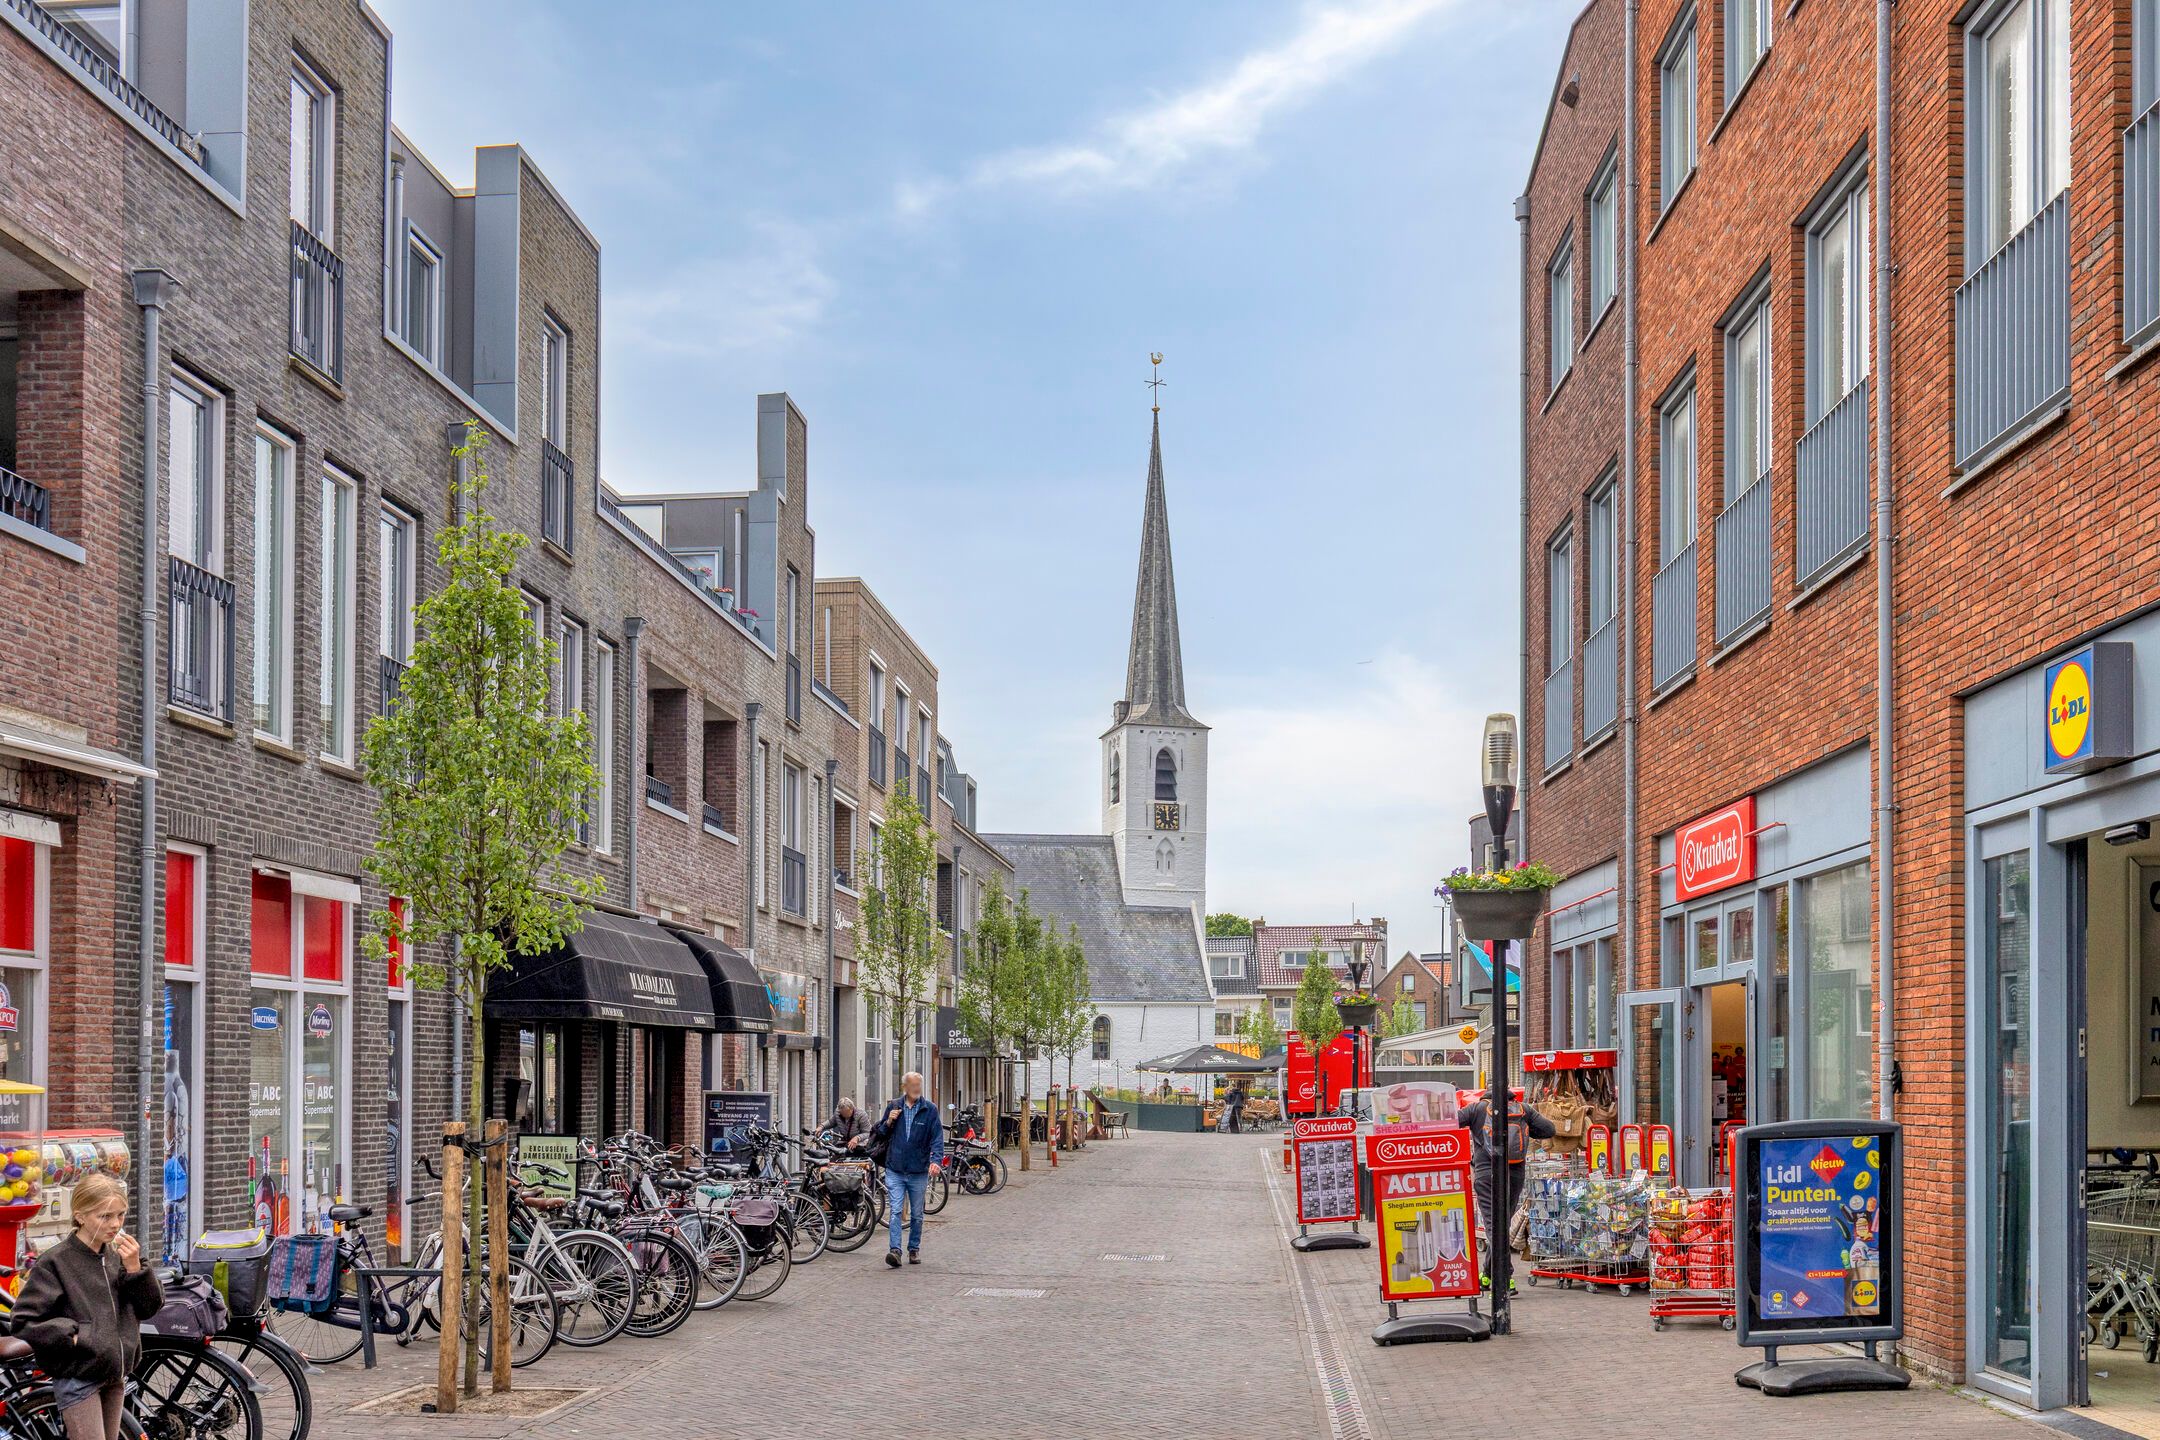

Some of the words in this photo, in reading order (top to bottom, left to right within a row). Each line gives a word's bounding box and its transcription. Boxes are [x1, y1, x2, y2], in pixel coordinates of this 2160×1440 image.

[2052, 695, 2087, 725] LIDL
[1696, 829, 1737, 872] Kruidvat
[629, 972, 676, 996] MAGDALENA
[263, 1086, 281, 1100] ABC
[317, 1085, 334, 1099] ABC
[249, 1106, 281, 1118] Supermarkt
[304, 1105, 334, 1117] Supermarkt
[1310, 1121, 1352, 1132] Kruidvat
[1376, 1125, 1418, 1134] SHEGLAM
[1398, 1141, 1453, 1156] Kruidvat
[1810, 1159, 1845, 1170] Nieuw
[1767, 1165, 1802, 1183] Lidl
[1388, 1170, 1460, 1194] ACTIE!
[1767, 1186, 1842, 1203] Punten.
[1767, 1217, 1788, 1226] gratis
[1789, 1216, 1830, 1225] producten!
